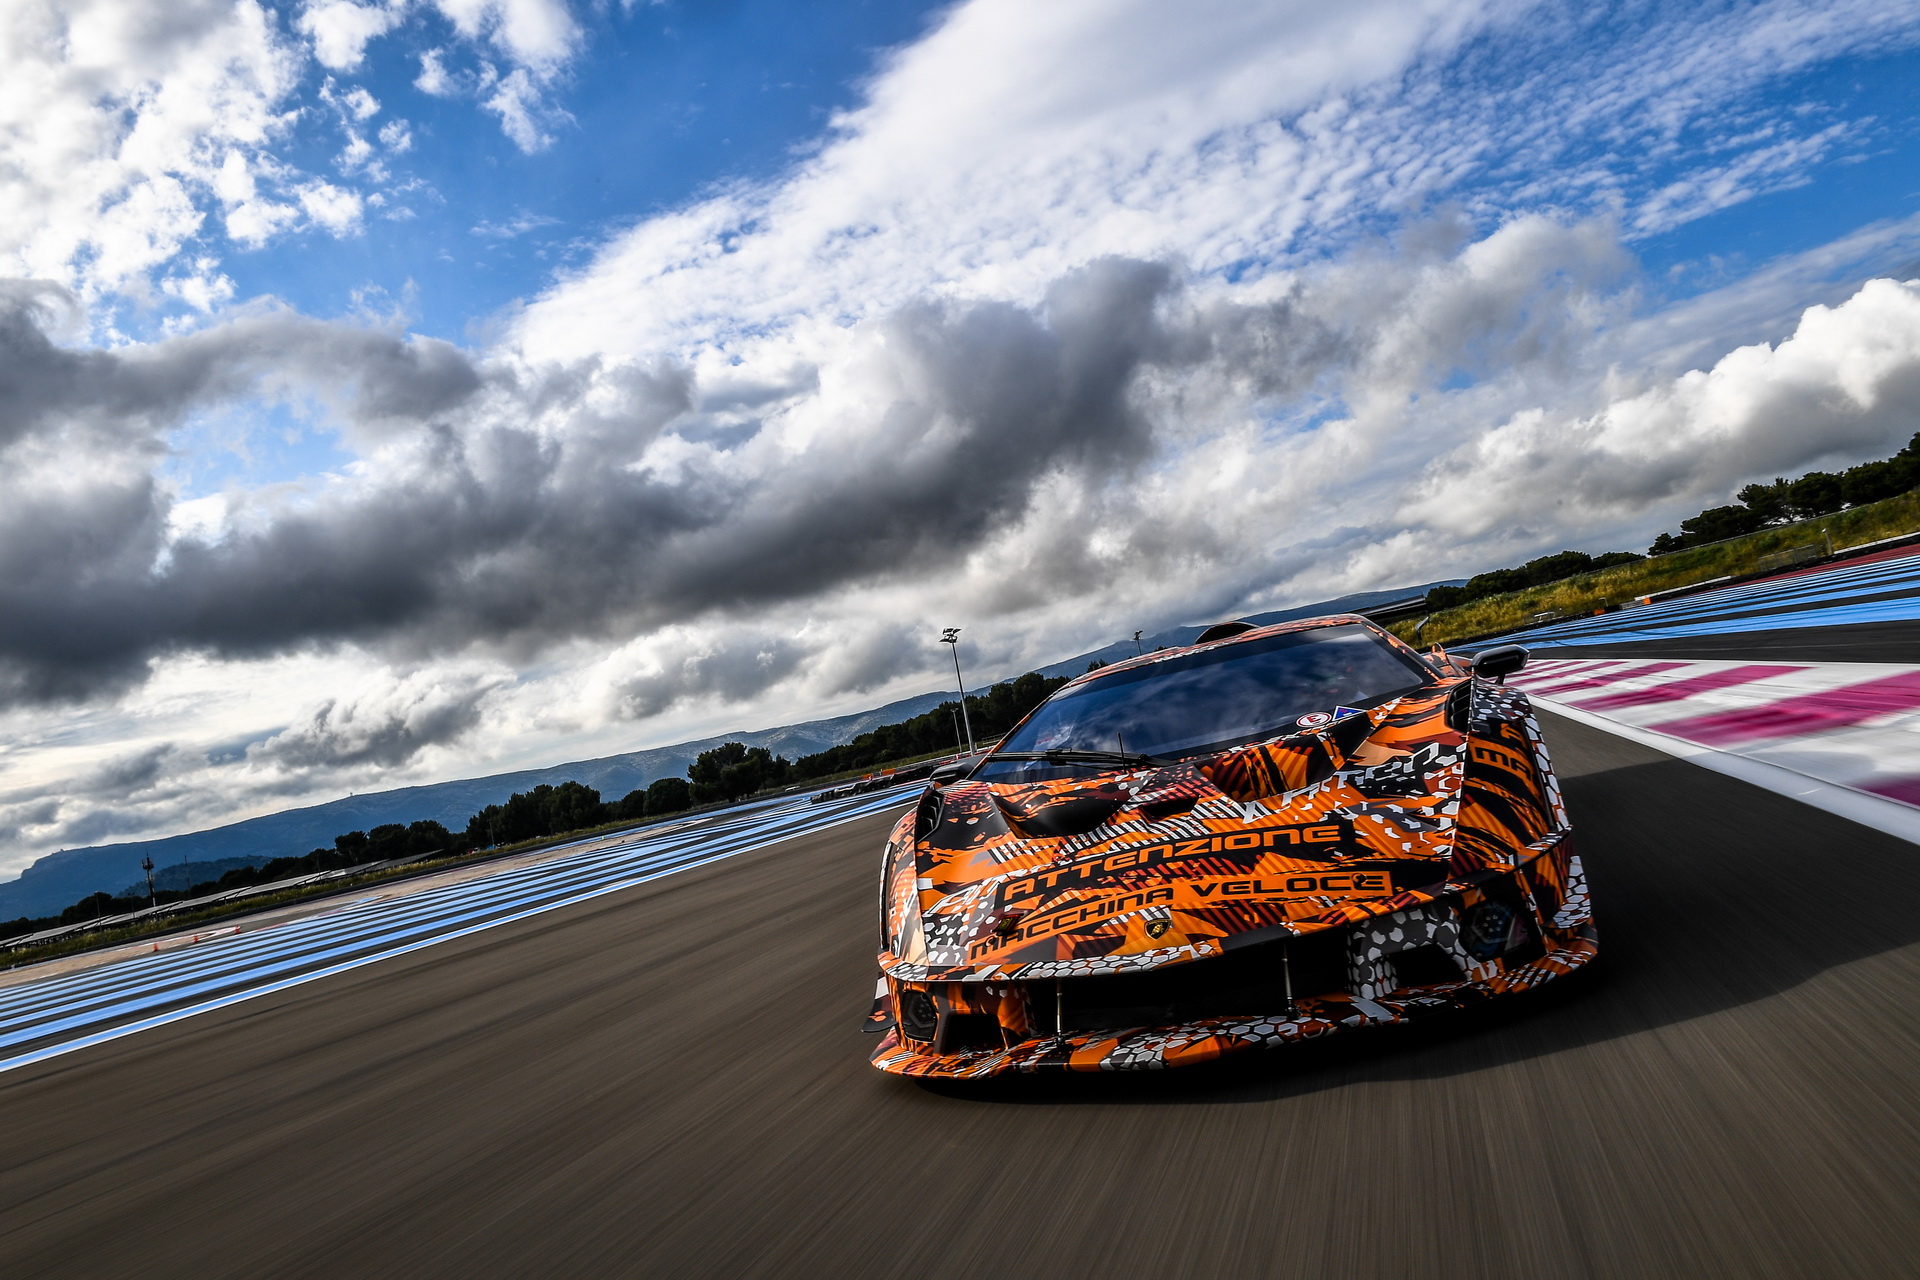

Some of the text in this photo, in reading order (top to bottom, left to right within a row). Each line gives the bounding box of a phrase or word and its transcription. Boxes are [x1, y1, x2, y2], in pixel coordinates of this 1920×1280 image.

[1003, 824, 1342, 901] ATTENZIONE
[969, 887, 1174, 961] MACCHINA
[1199, 874, 1385, 897] VELOCE
